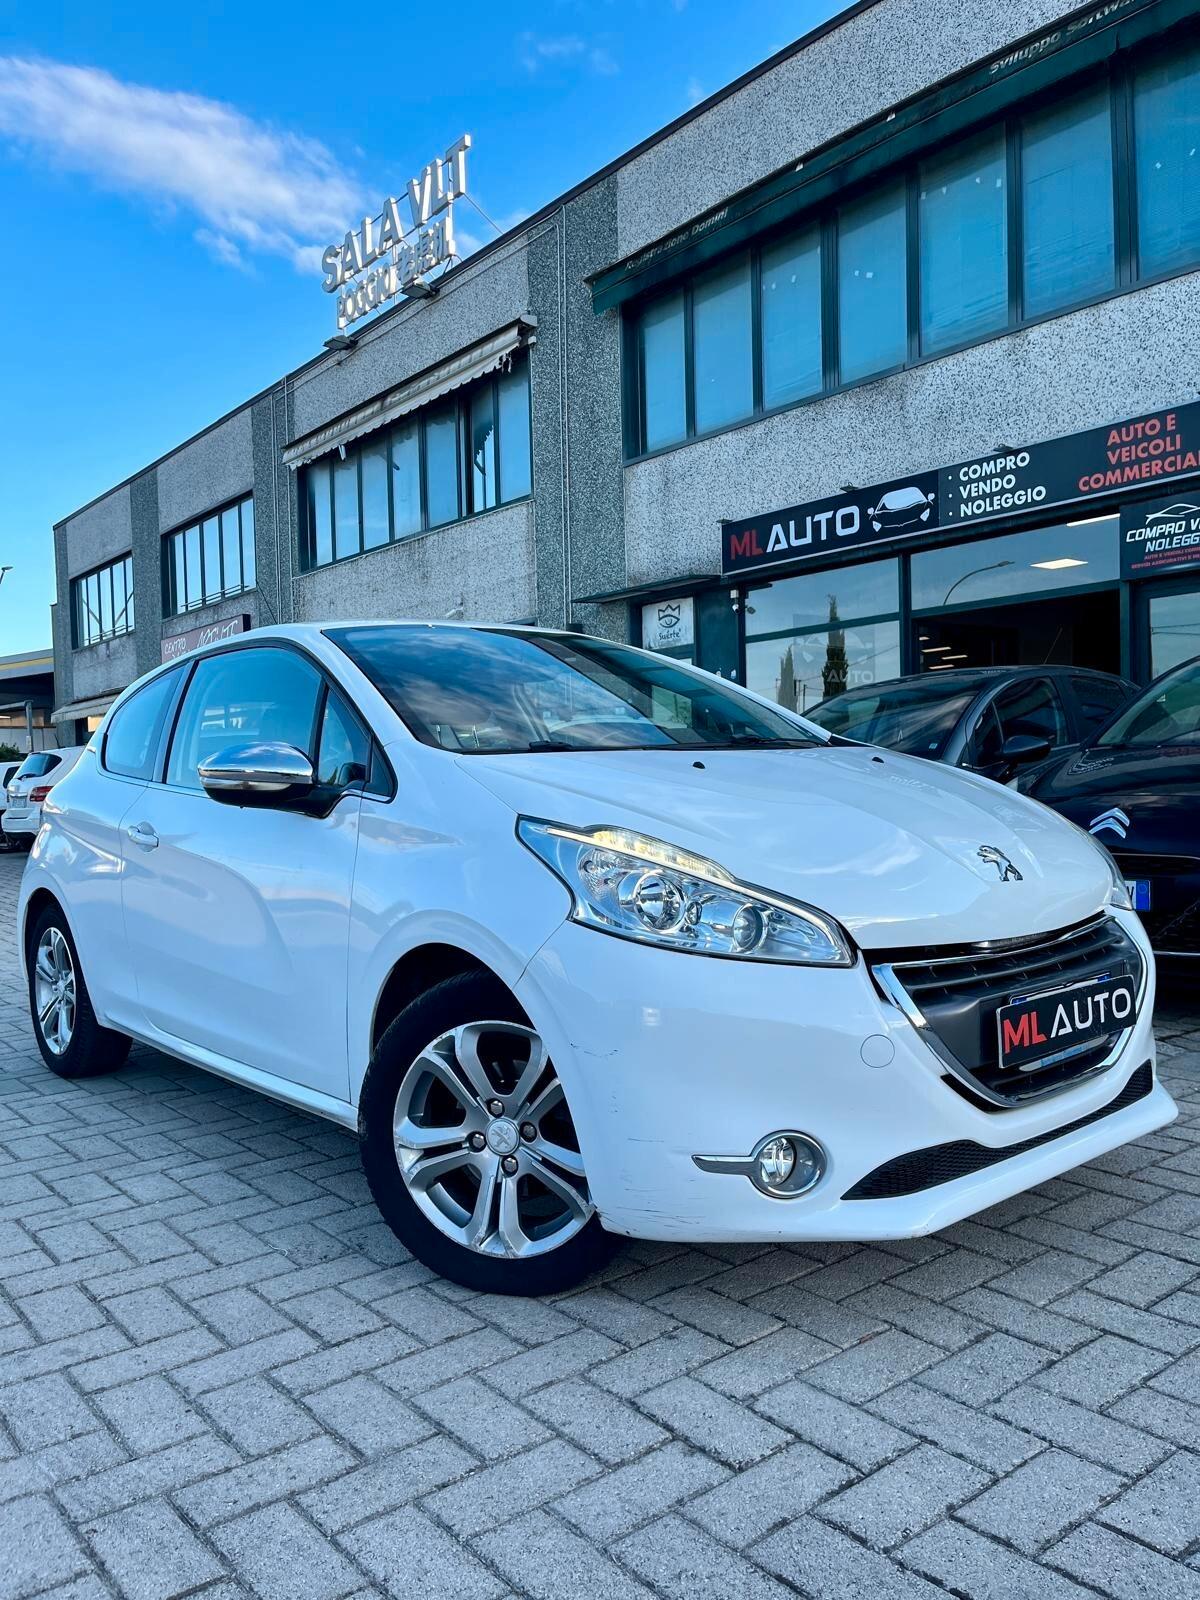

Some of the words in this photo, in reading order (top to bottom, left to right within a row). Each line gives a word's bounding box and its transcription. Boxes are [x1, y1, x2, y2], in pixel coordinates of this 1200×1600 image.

[989, 31, 1062, 75] Sviluppo
[321, 197, 404, 293] SALA
[406, 134, 471, 228] VLT
[1106, 418, 1161, 447] AUTO
[1165, 413, 1176, 432] E
[1106, 434, 1181, 465] VEICOLI
[959, 451, 1030, 481] COMPRO
[959, 474, 1016, 499] VENDO
[960, 485, 1047, 517] NOLEGGIO
[730, 528, 763, 560] ML
[765, 505, 860, 553] AUTO
[1125, 520, 1187, 542] COMPRO
[1190, 517, 1200, 531] V
[1145, 532, 1200, 553] NOLEGG
[164, 637, 187, 655] CENTRO
[827, 669, 875, 683] AUTO
[1003, 1010, 1048, 1055] ML
[1050, 987, 1132, 1040] AUTO
